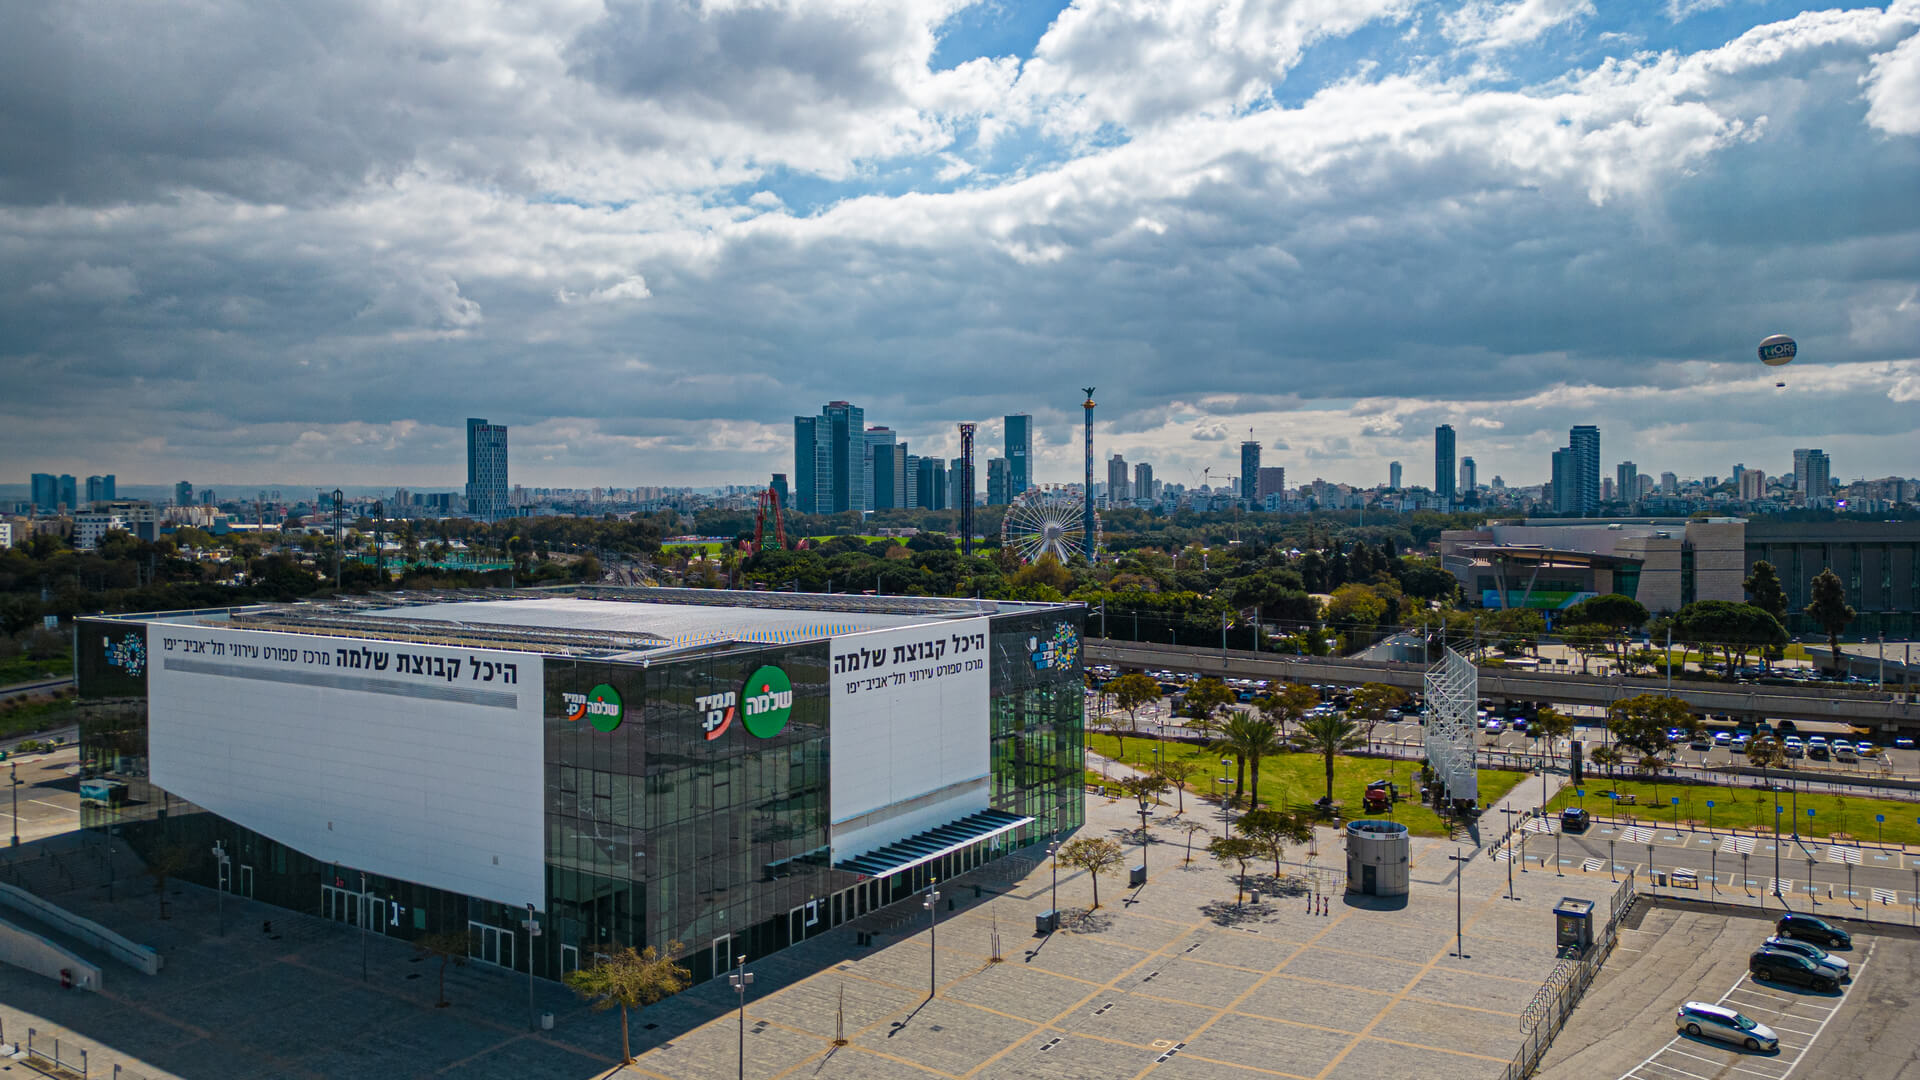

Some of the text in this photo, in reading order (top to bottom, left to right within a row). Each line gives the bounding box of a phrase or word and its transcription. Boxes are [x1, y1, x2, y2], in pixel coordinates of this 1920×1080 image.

[230, 644, 259, 658] עירוני
[264, 647, 298, 662] ספורט
[303, 650, 330, 665] מרכז
[336, 646, 389, 670] שלמה
[834, 634, 984, 674] היכל קבוצת שלמה
[396, 653, 461, 682] קבוצת
[470, 656, 517, 684] היכל
[936, 662, 962, 677] ספורט
[965, 658, 983, 671] מרכז
[910, 668, 934, 681] עירוני
[562, 693, 587, 704] תמיד
[695, 691, 736, 712] תמיד
[746, 690, 792, 715] שלמה
[587, 701, 619, 716] שלמה
